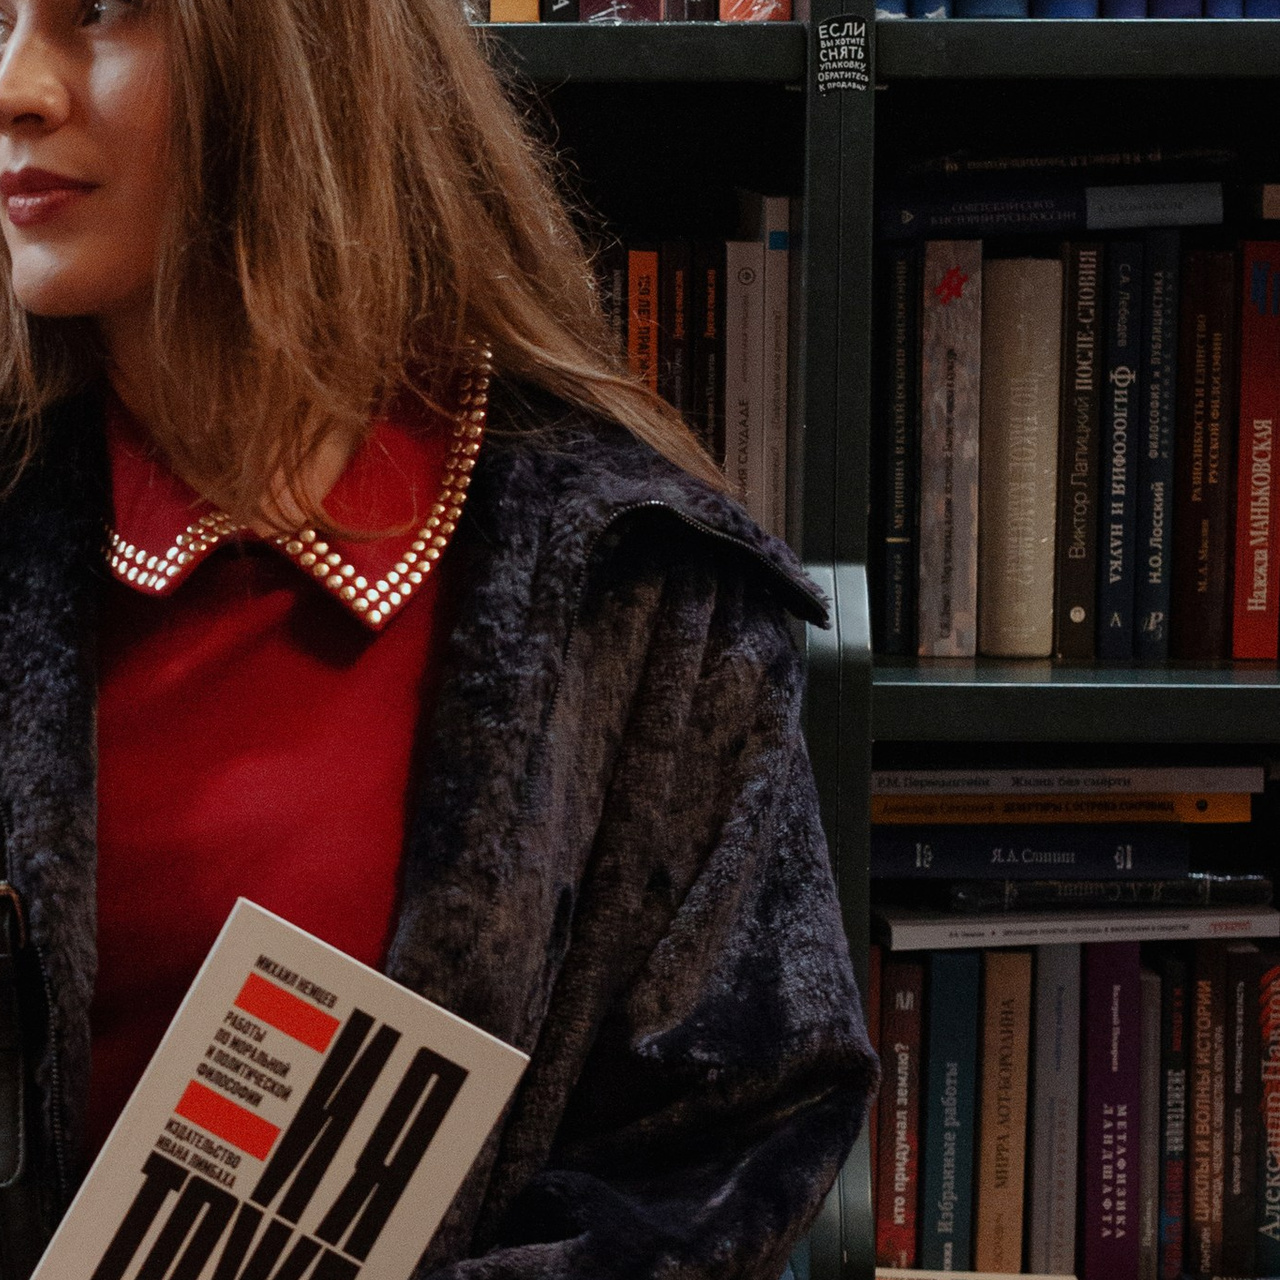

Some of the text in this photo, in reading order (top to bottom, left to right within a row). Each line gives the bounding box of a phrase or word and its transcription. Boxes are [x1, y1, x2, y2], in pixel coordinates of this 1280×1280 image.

[818, 22, 865, 38] ЕСЛИ
[820, 38, 865, 48] ВЫ ХОТИТЕ
[820, 46, 864, 61] СНЯТЬ
[820, 60, 866, 72] УПАКОВКУ,
[818, 71, 869, 82] ОБРАТИТЕСЬ
[819, 84, 825, 92] К
[1075, 249, 1098, 391] ПОСЛЕ-СЛОВИЯ
[1068, 396, 1092, 560] Виктор Лапицкий
[1249, 419, 1272, 546] МАНЬКОВСКАЯ
[223, 1011, 267, 1043] РАБОТЫ
[213, 1049, 292, 1102] ПОЛИТИЧЕСКОЙ
[228, 1035, 291, 1078] МОРАЛЬНОЙ
[196, 1062, 263, 1107] ФИЛОСОФИИ
[164, 1117, 242, 1169] ИЗДАТЕЛЬСТВО
[250, 1008, 469, 1261] И Я
[937, 1062, 960, 1234] Избранные работы
[154, 1134, 237, 1189] ИВАНА ЛИМБАХА
